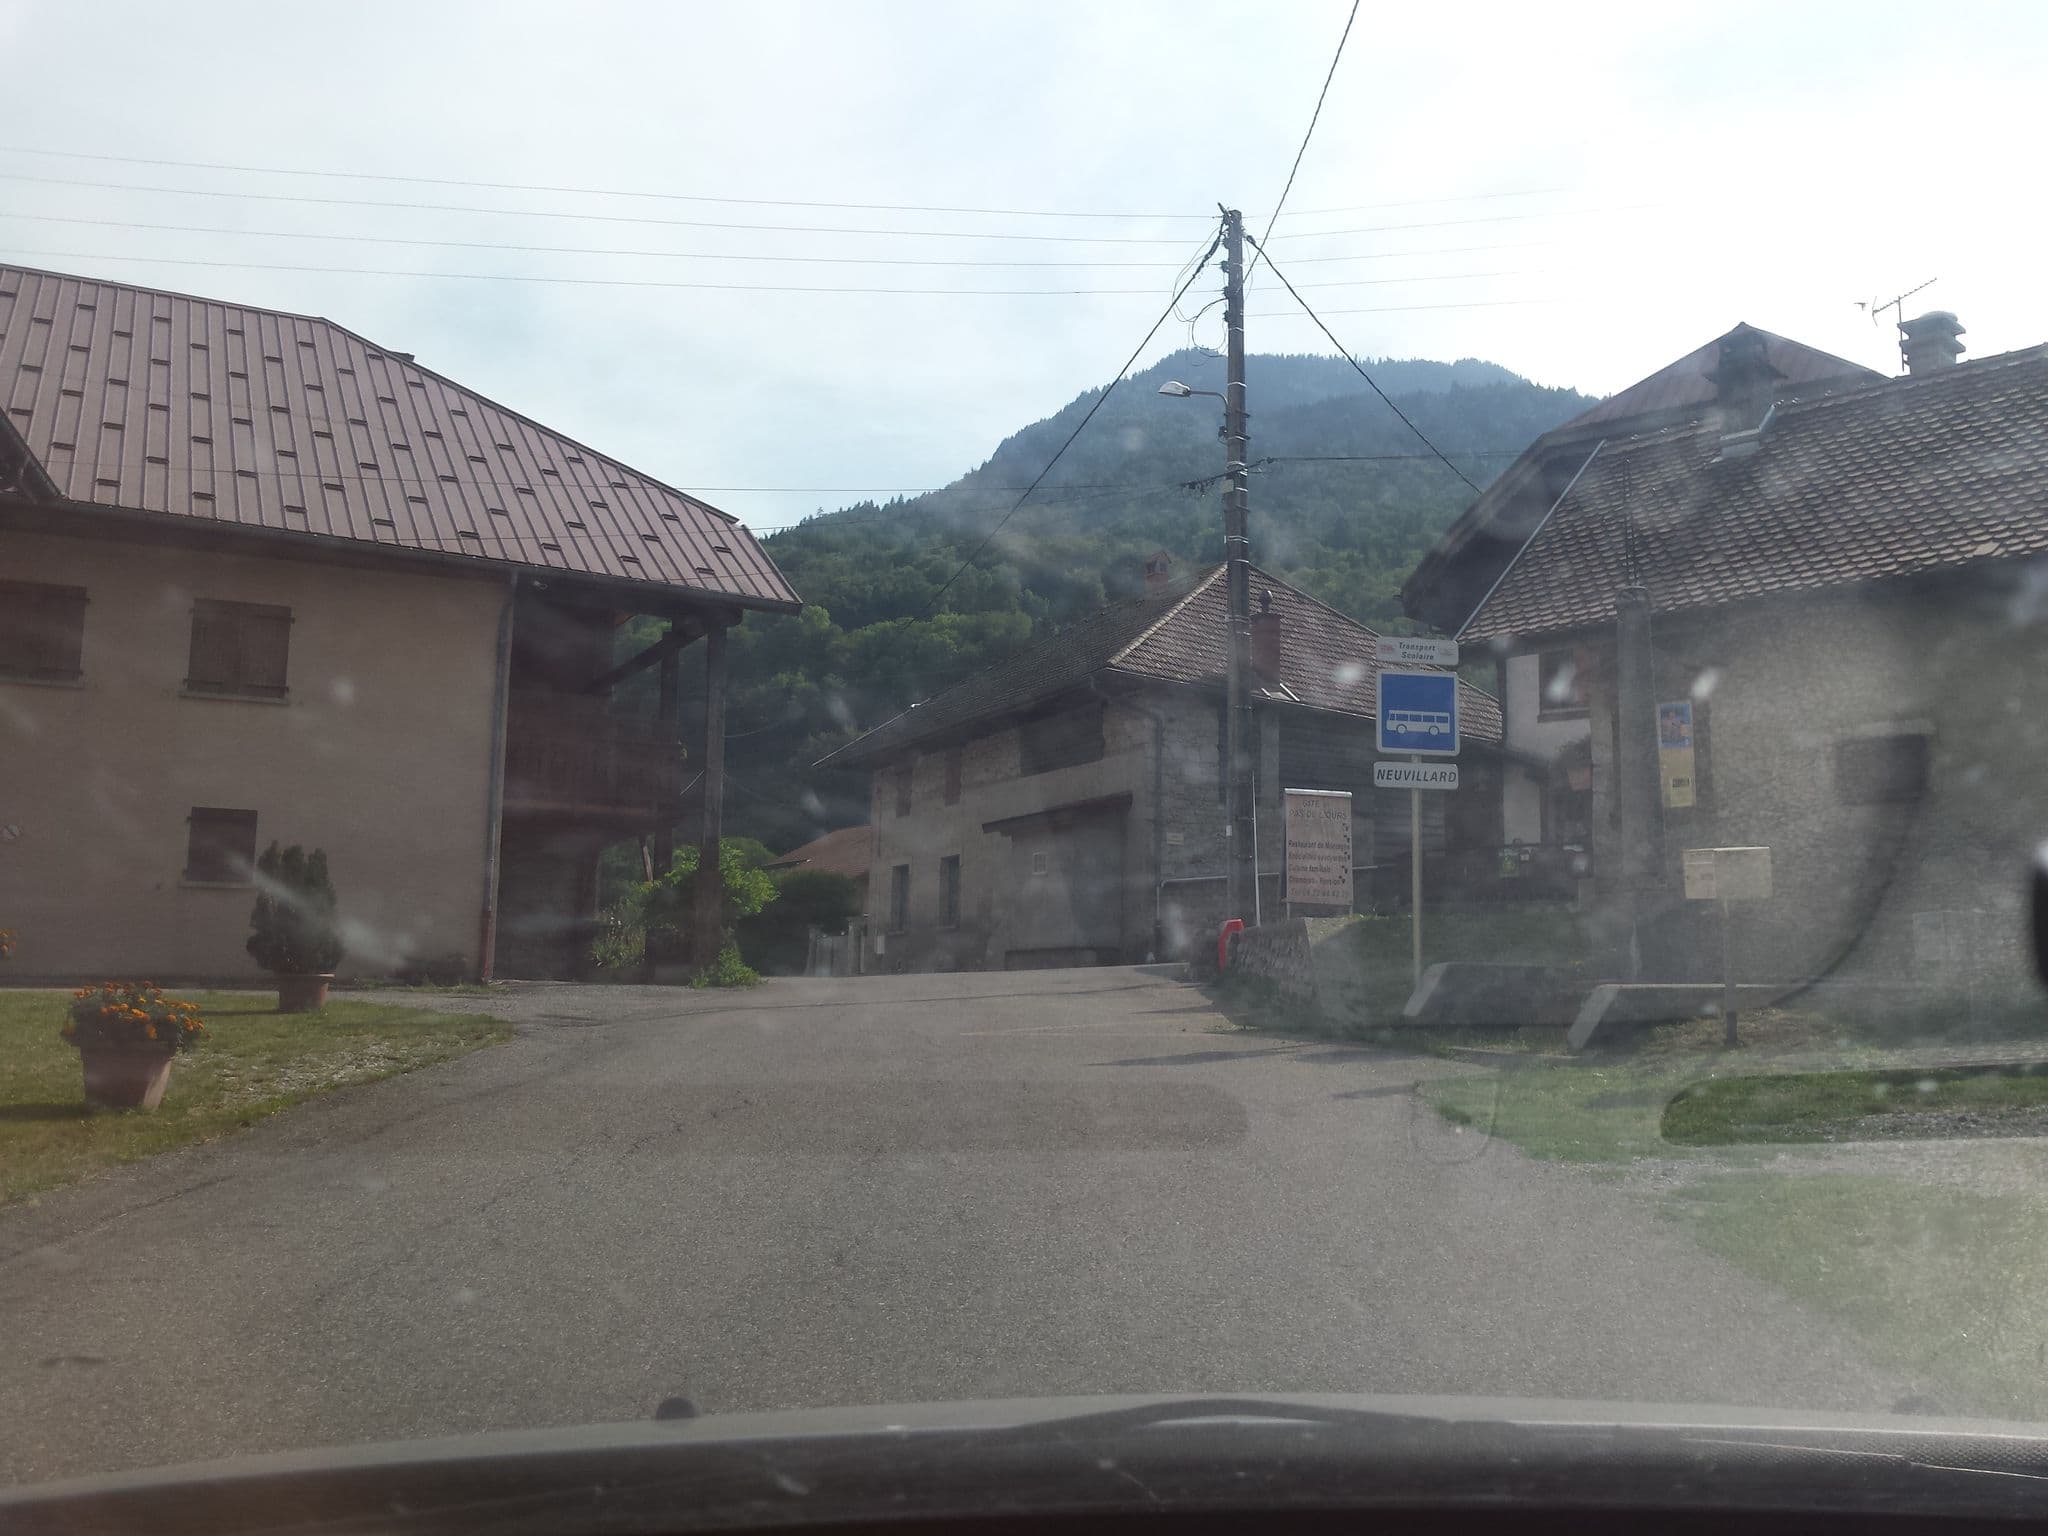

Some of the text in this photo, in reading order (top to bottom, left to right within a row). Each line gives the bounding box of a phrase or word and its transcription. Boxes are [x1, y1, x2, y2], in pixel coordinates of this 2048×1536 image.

[1400, 642, 1436, 652] Transport
[1401, 651, 1434, 660] Scolaire
[1376, 768, 1457, 783] NEUVILLARD
[1288, 839, 1317, 849] Restaurant
